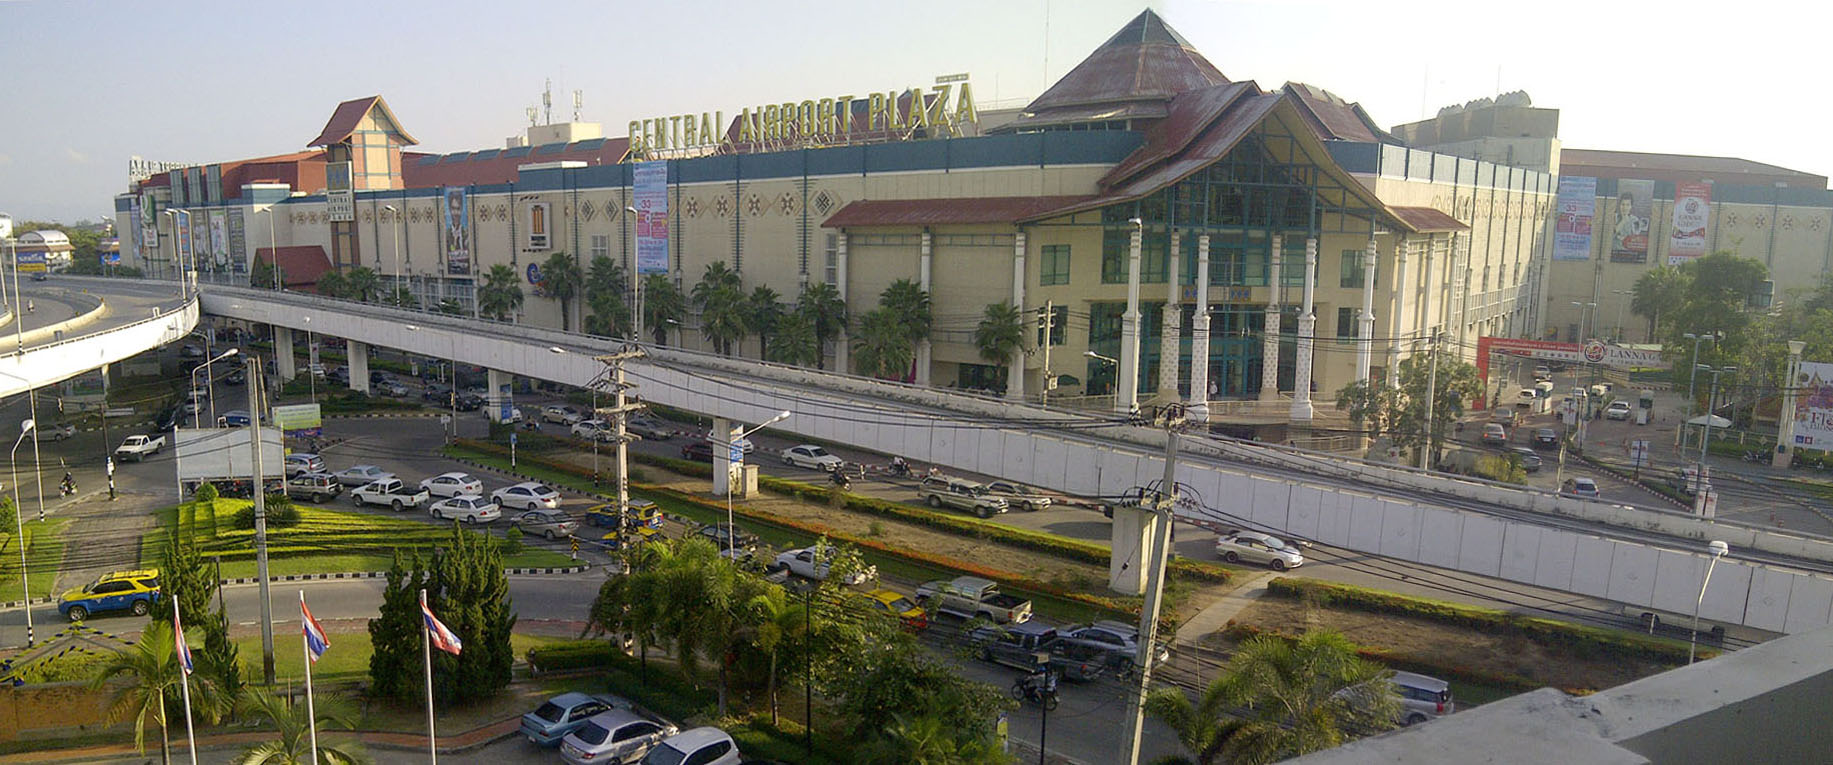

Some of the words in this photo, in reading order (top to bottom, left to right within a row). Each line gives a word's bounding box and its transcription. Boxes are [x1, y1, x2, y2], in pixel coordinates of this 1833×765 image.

[628, 110, 723, 152] CENTRAL
[739, 95, 855, 142] AIRPORT
[868, 82, 978, 131] PLAZA
[1610, 349, 1647, 360] LANNA
